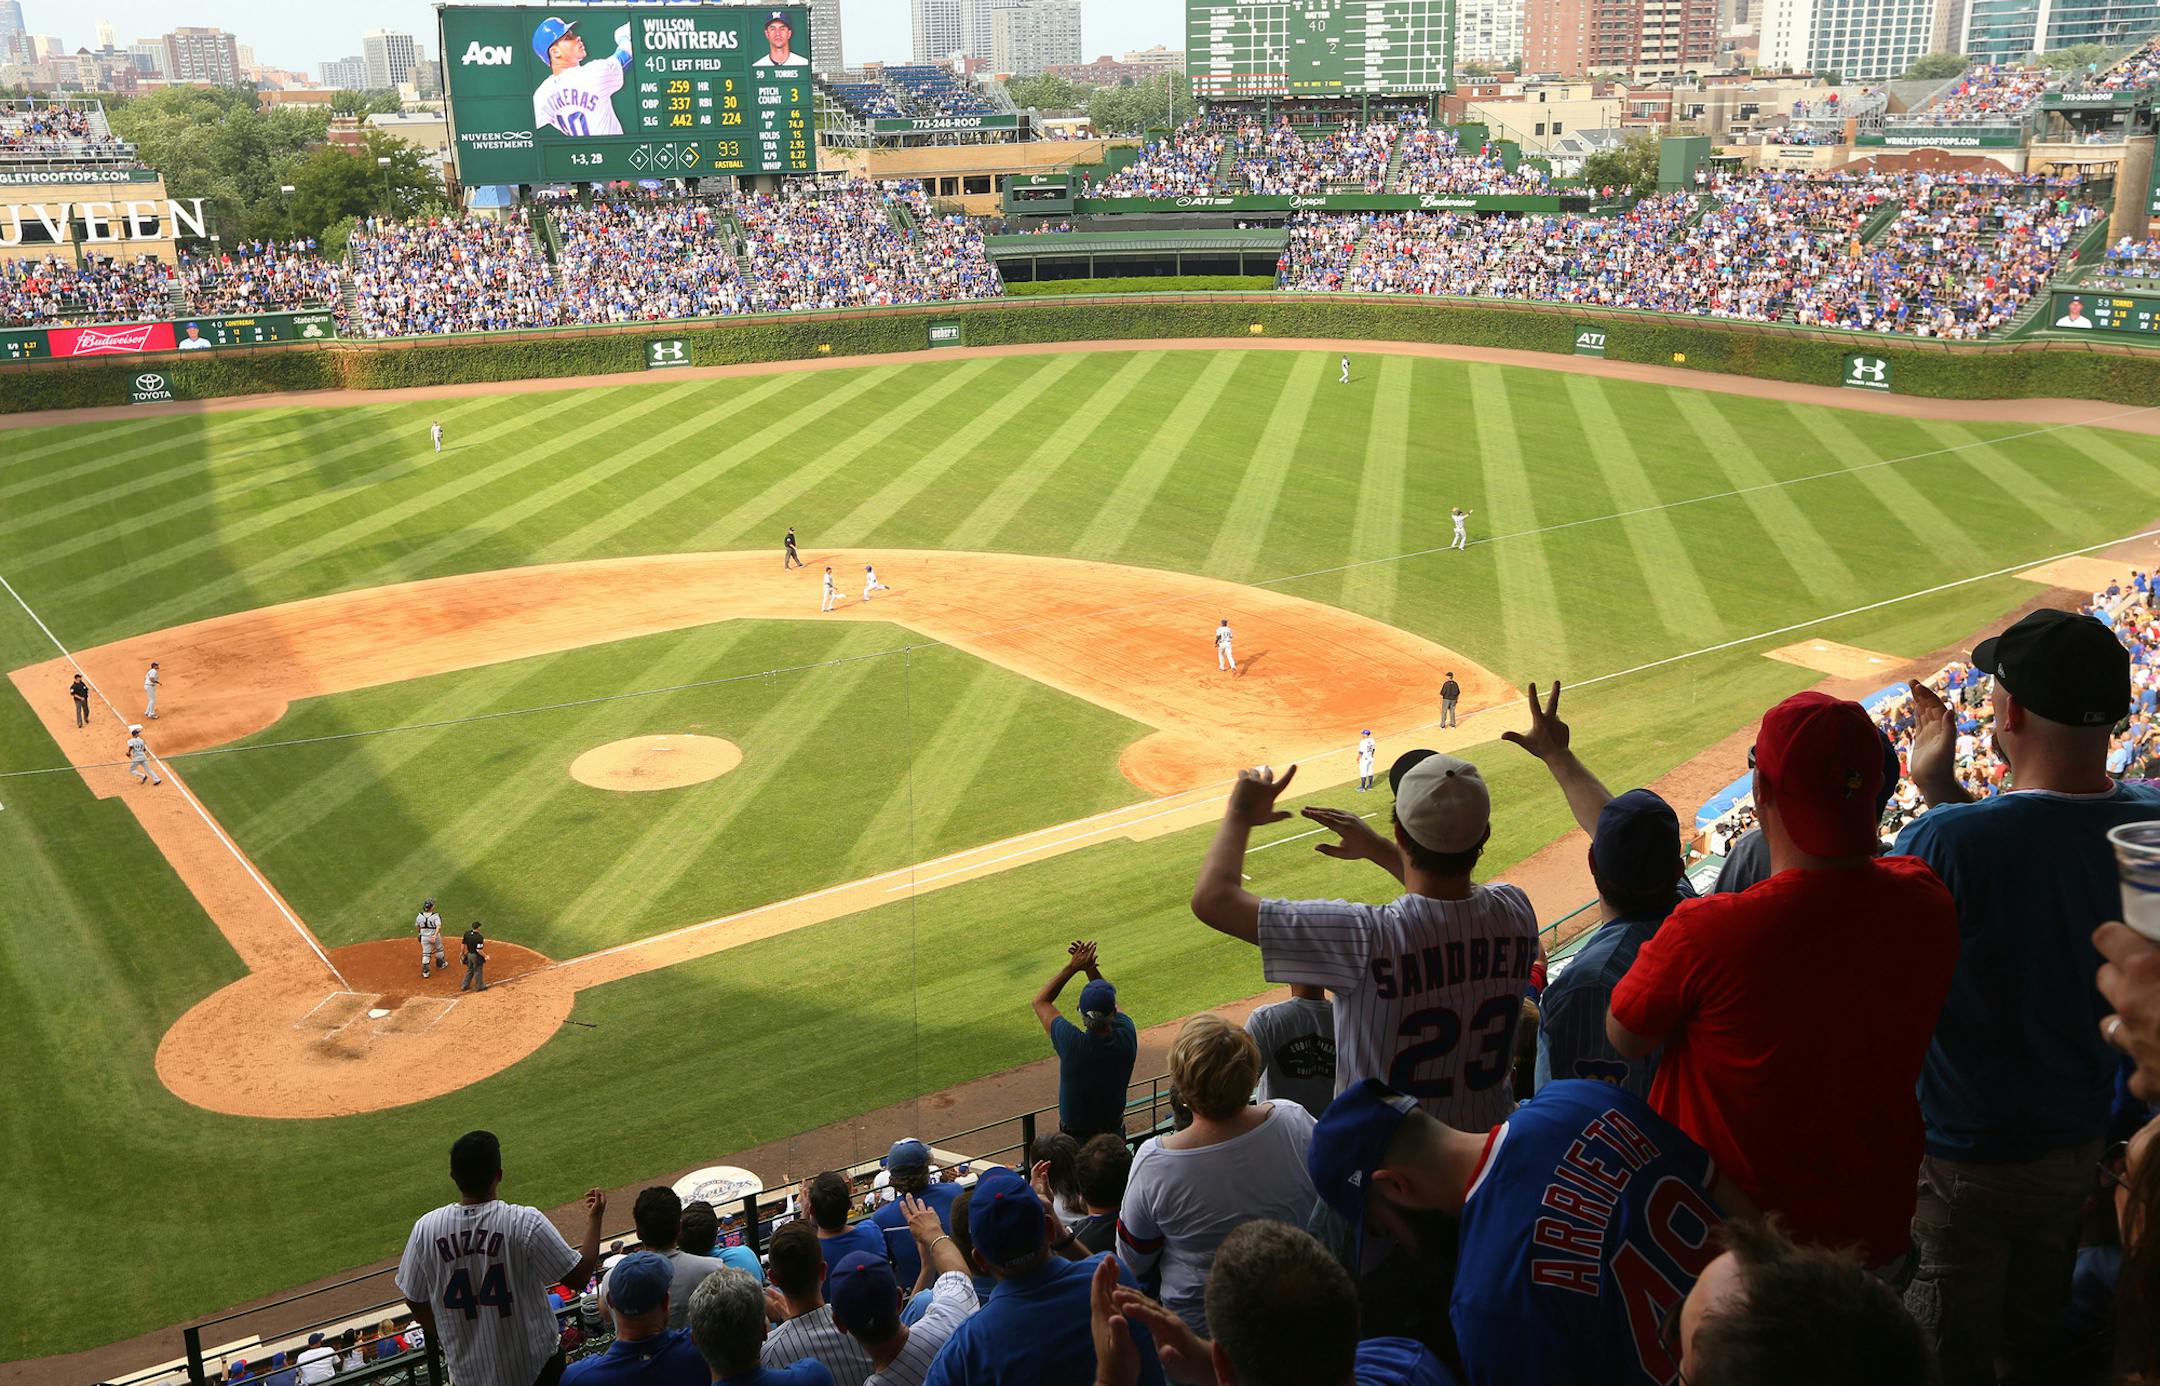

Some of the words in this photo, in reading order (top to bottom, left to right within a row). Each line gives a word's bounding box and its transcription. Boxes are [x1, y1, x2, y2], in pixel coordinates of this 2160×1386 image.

[643, 18, 695, 32] WILLSON
[1308, 20, 1326, 32] 40
[644, 31, 738, 50] CONTRERAS
[1329, 43, 1336, 54] 2
[645, 56, 666, 72] 40
[672, 59, 692, 71] LEFT
[694, 59, 721, 70] FIELD
[774, 70, 798, 78] TORRES
[641, 82, 658, 92] AVG
[666, 80, 690, 93] .259
[698, 82, 710, 91] HR
[725, 79, 732, 92] 9
[758, 87, 779, 96] PITCH
[758, 96, 782, 104] COUNT
[790, 88, 798, 102] 3
[642, 99, 659, 109] OBP
[668, 97, 691, 110] .337
[698, 98, 712, 107] RBI
[724, 96, 737, 108] 30
[644, 116, 658, 126] SLG
[670, 114, 692, 126] .442
[700, 115, 712, 124] AB
[722, 112, 742, 125] 224
[761, 111, 776, 120] APP
[912, 118, 981, 129] 773-248-ROOF
[461, 132, 501, 142] NUVEEN
[760, 132, 780, 140] HOLDS
[1885, 137, 1979, 146] WRIGLEYROOFTOPS.COM
[472, 140, 534, 150] INVESTMENTS
[718, 141, 739, 156] 93
[763, 142, 777, 150] ERA
[715, 160, 744, 168] FASTBALL
[762, 162, 782, 170] WHIP
[0, 172, 130, 184] GLEYROOFTOPS.COM
[1302, 197, 1326, 206] pepsi
[1419, 195, 1477, 208] Budweiser
[225, 320, 256, 328] CONTRERAS
[78, 334, 146, 348] Budweiser
[1577, 333, 1605, 345] ATI
[133, 390, 172, 400] TOYOTA
[1387, 994, 1520, 1099] 23
[1532, 1108, 1662, 1297] ARRIETA
[434, 1229, 505, 1263] RIZZO
[443, 1262, 514, 1320] 44
